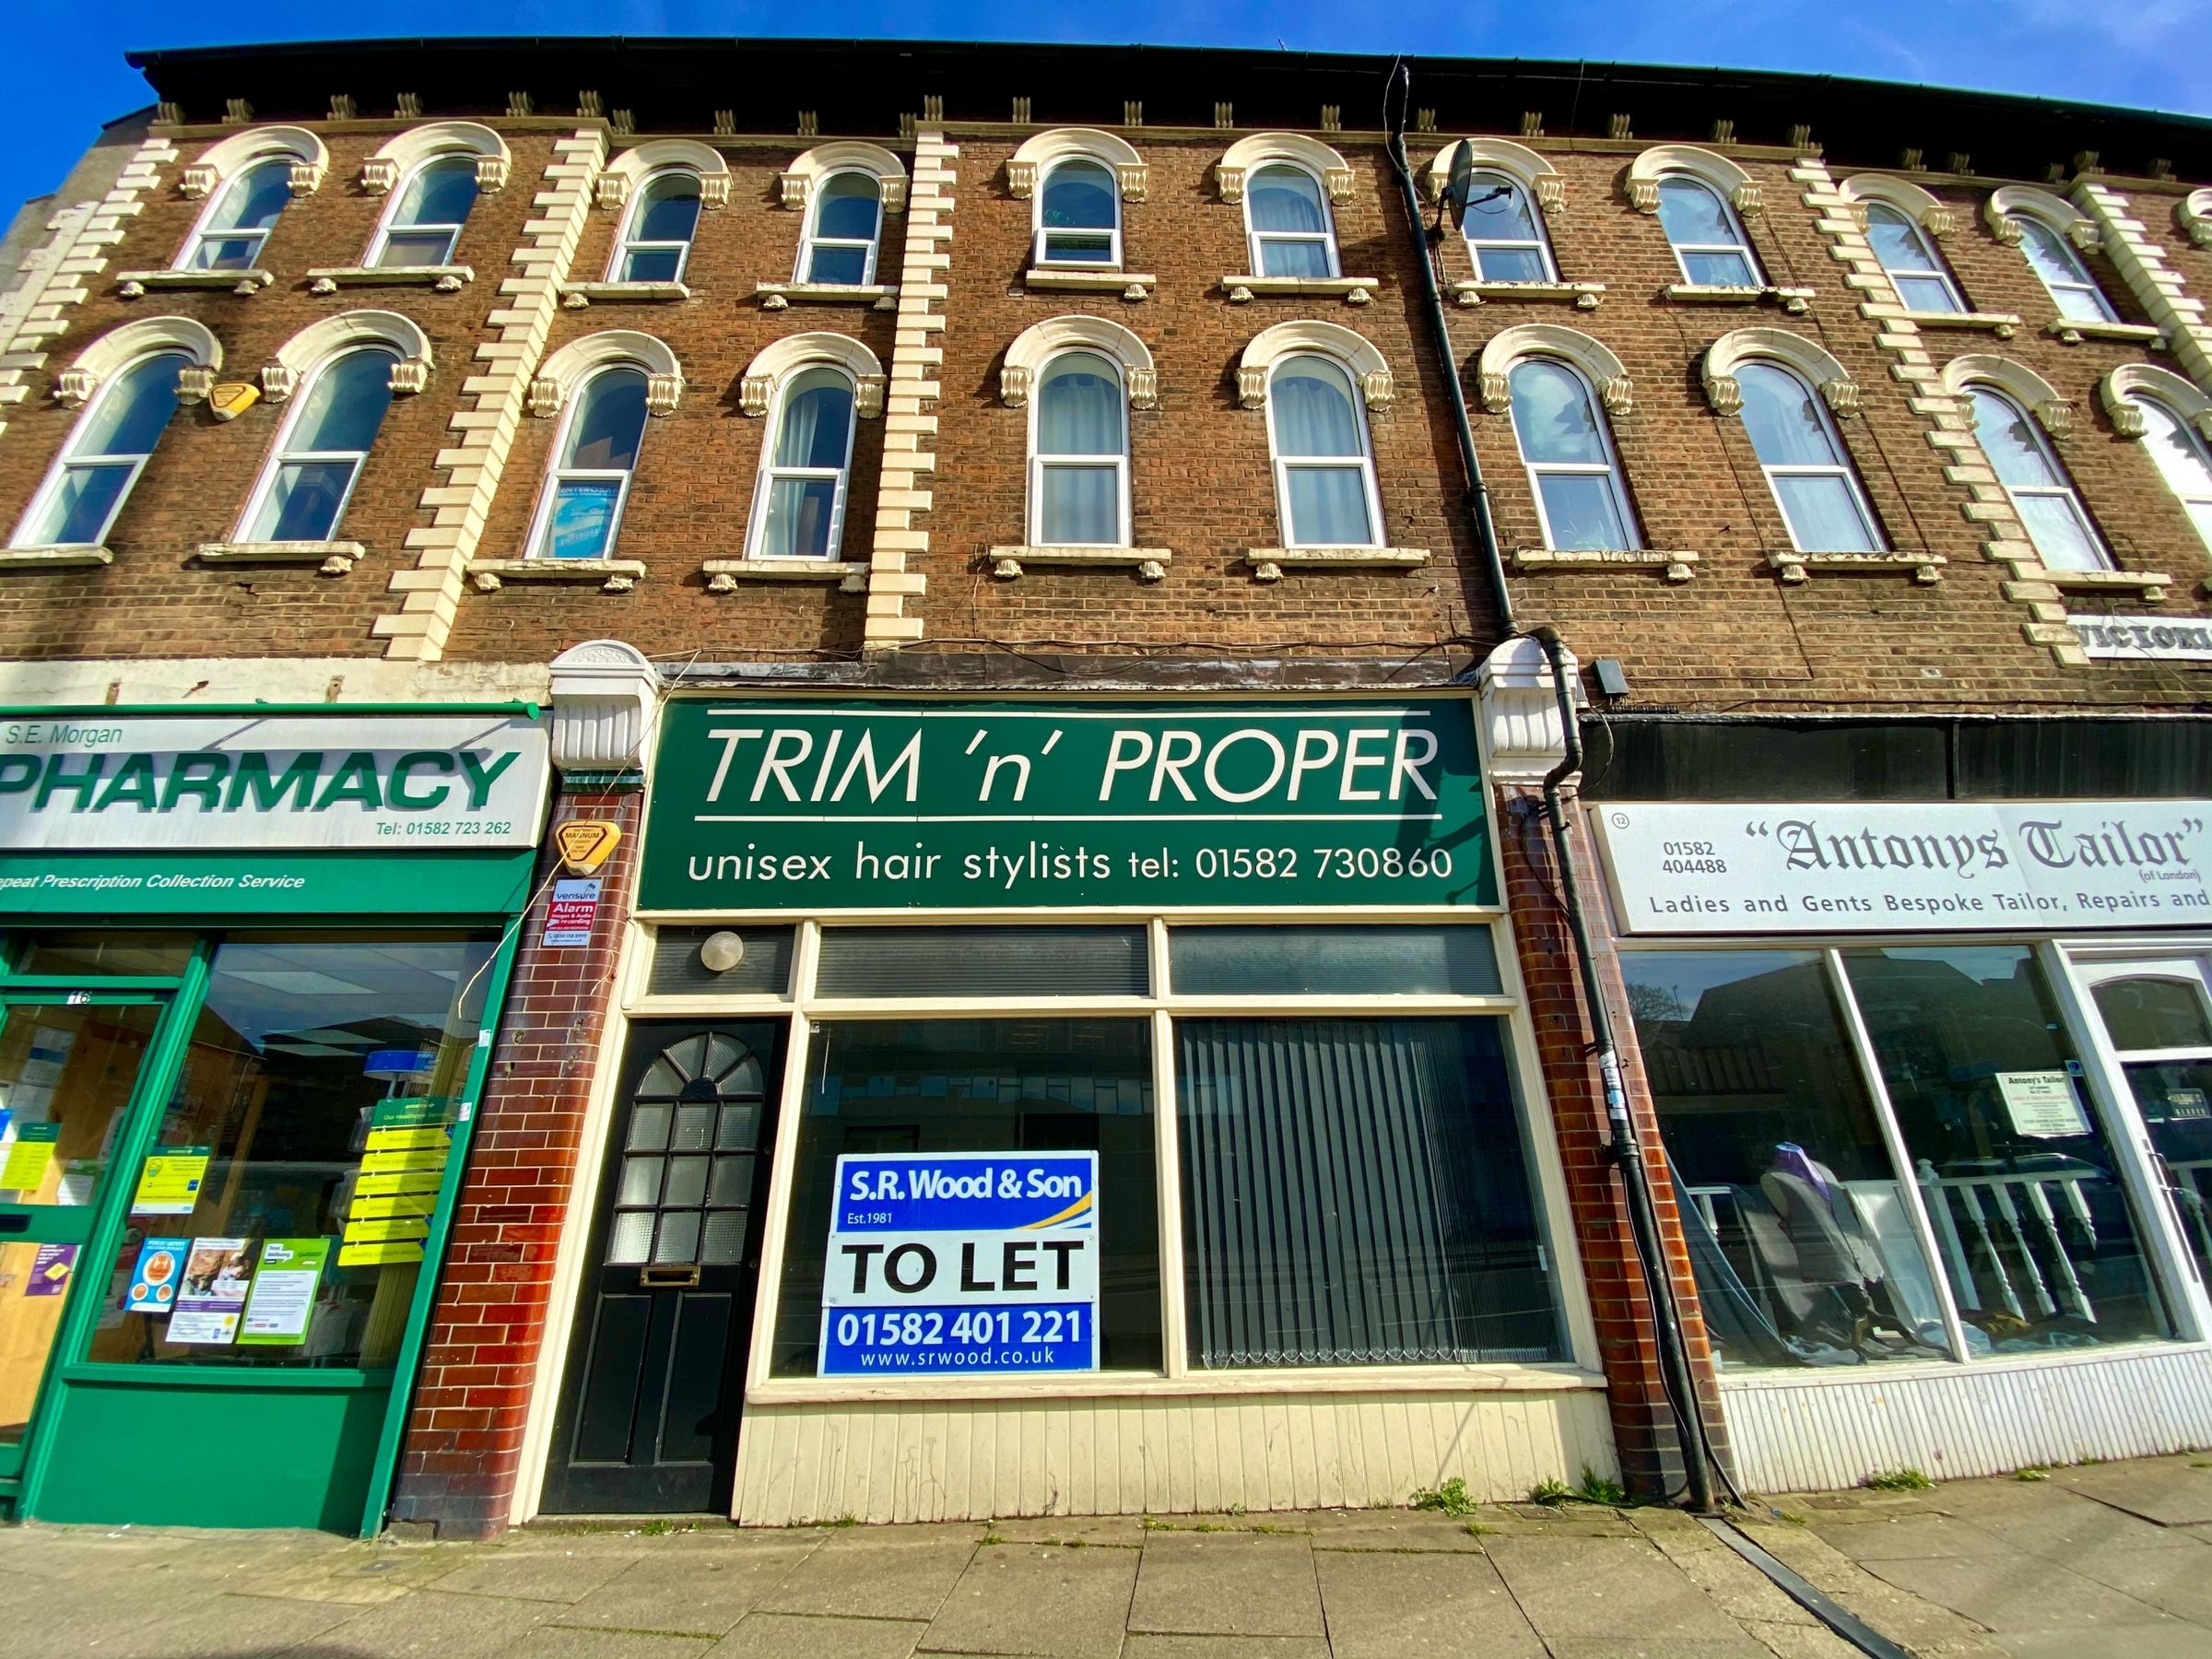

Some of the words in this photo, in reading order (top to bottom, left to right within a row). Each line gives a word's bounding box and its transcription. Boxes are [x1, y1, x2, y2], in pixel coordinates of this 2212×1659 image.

[6, 724, 42, 744] S.E.
[49, 724, 123, 747] Morgan
[706, 728, 923, 804] TRIM
[1099, 728, 1440, 805] PROPER
[0, 751, 521, 813] PHARMACY
[376, 822, 403, 835] Tel:
[406, 822, 451, 835] 01582
[454, 822, 480, 834] 723
[485, 822, 512, 834] 262
[1616, 817, 1626, 825] 12
[1663, 841, 1716, 856] 01582
[689, 842, 833, 882] unisex
[856, 841, 943, 881] hair
[964, 841, 1112, 890] stylists
[1129, 848, 1181, 879] tel:
[1195, 848, 1299, 880] 01582
[1313, 848, 1454, 880] 730860
[1662, 859, 1727, 874] 404488
[42, 875, 143, 891] Prescription
[147, 874, 236, 888] Collection
[239, 874, 307, 888] Service
[2138, 868, 2158, 883] (of
[2158, 868, 2202, 883] London)
[552, 902, 594, 913] Alarm
[1650, 895, 1731, 914] Ladies
[1744, 894, 1789, 913] and
[1802, 895, 1873, 912] Gents
[1884, 892, 1984, 915] Bespoke
[1993, 890, 2068, 912] Tailor,
[2076, 890, 2161, 912] Repairs
[2171, 888, 2211, 907] and
[2008, 1077, 2041, 1085] Antony's
[2042, 1076, 2065, 1084] Tailor
[850, 1170, 906, 1201] S.R.
[907, 1166, 994, 1199] Wood
[997, 1169, 1024, 1199] &
[1026, 1168, 1083, 1199] Son
[847, 1212, 892, 1225] Est.1981
[841, 1242, 938, 1295] TO
[959, 1240, 1086, 1294] LET
[837, 1312, 944, 1347] 01582
[950, 1311, 1010, 1345] 401
[1021, 1310, 1080, 1344] 221
[860, 1346, 1054, 1366] www.srwood.co.uk
